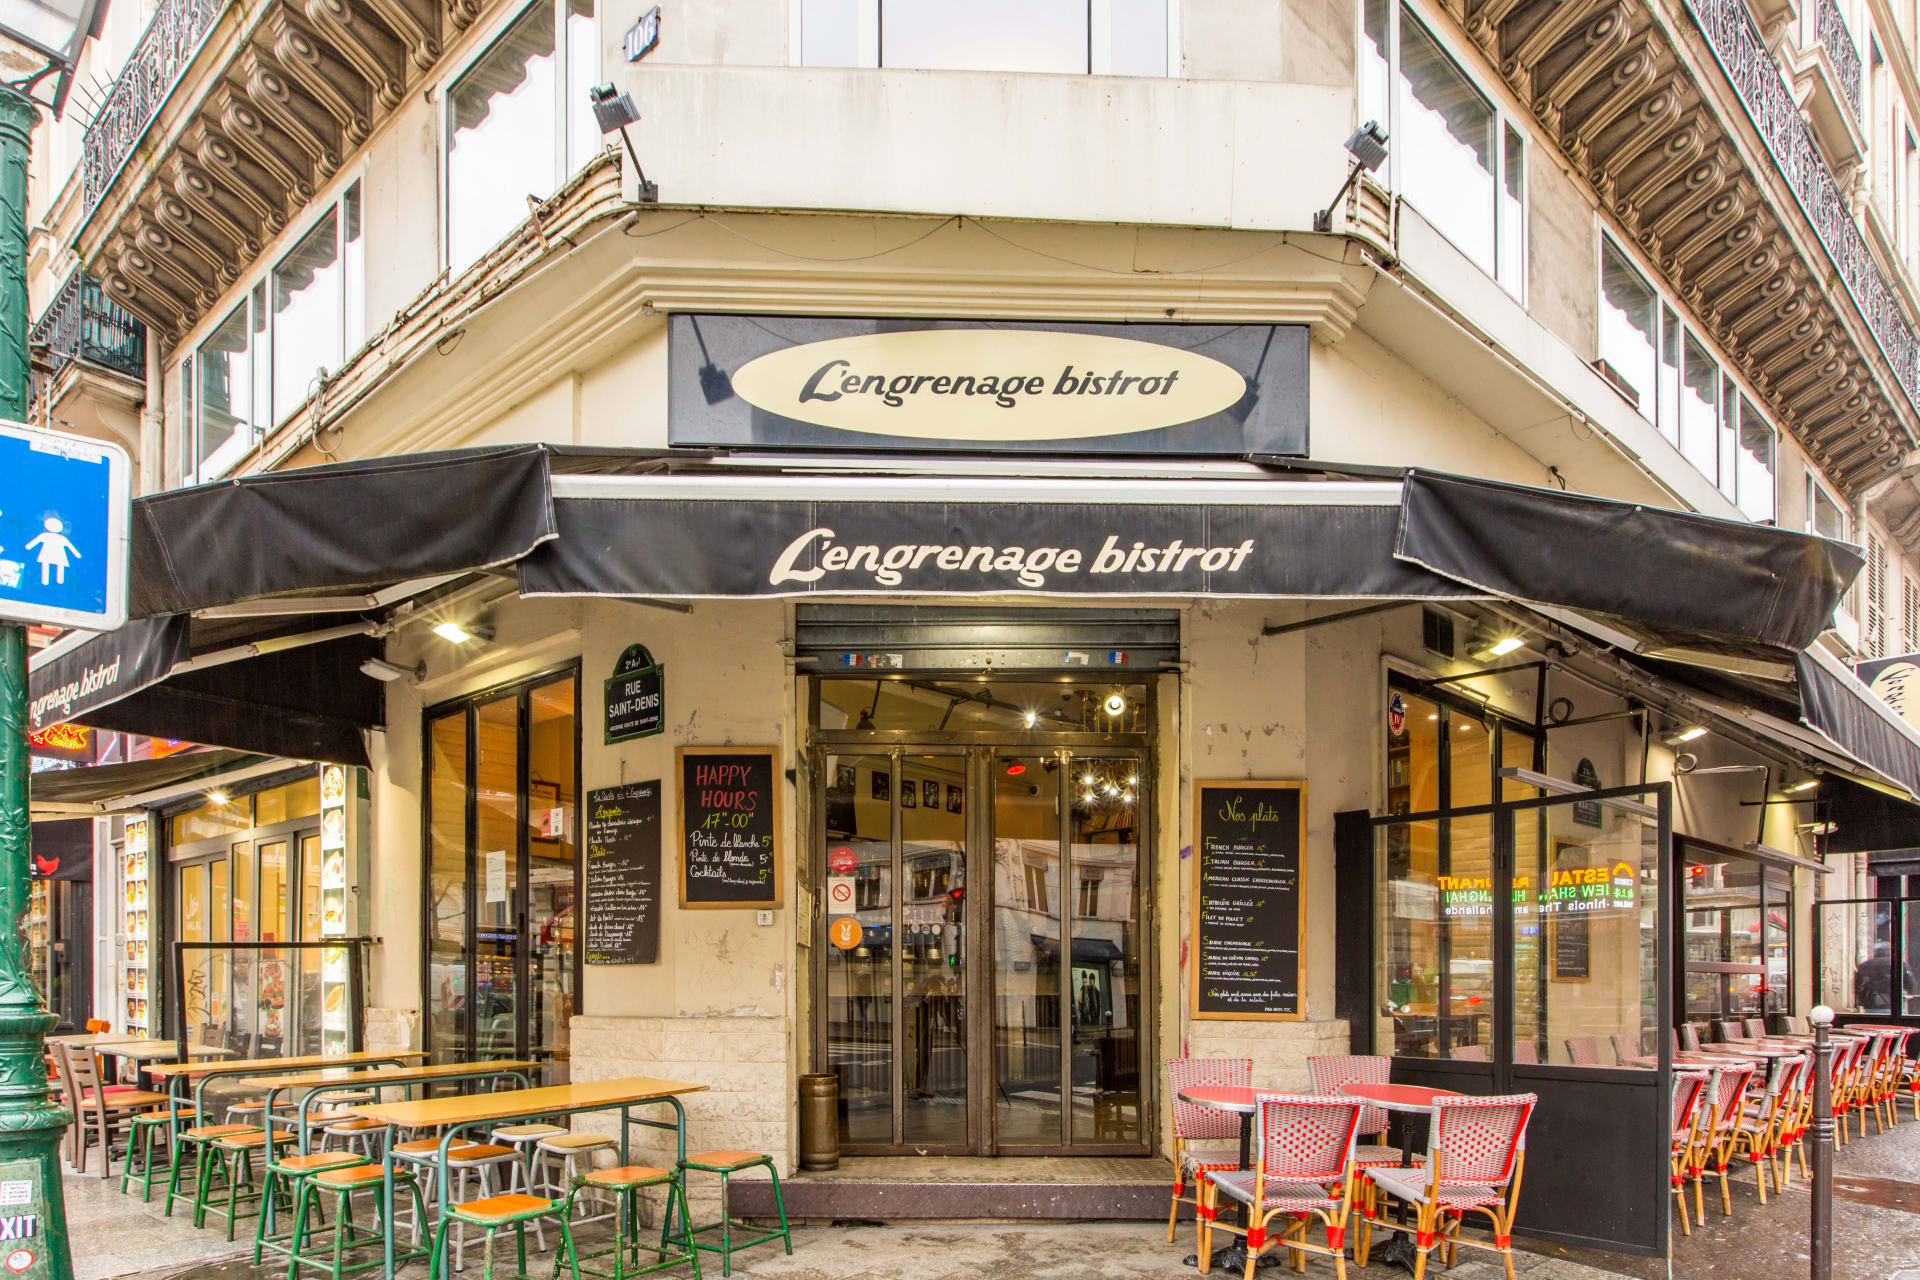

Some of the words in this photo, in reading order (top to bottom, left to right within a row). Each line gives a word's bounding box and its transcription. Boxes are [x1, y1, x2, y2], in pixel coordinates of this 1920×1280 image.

[798, 359, 1045, 409] L'engrenage
[1052, 365, 1179, 398] bistrot
[769, 528, 1080, 588] L'engrenage
[1089, 536, 1256, 575] bistrot
[79, 654, 120, 697] bistrot
[625, 680, 641, 696] RUE
[609, 692, 659, 719] SAINT-DENIS
[696, 765, 752, 786] HAPPY
[701, 790, 758, 811] HOURS
[1219, 796, 1246, 823] Nos
[1249, 801, 1280, 832] plats
[690, 830, 718, 848] Pinte
[720, 832, 732, 848] de
[733, 833, 760, 848] blanche
[690, 848, 709, 863] Pinte
[712, 851, 721, 863] de
[723, 850, 750, 862] blonde
[689, 864, 727, 878] Cocktails
